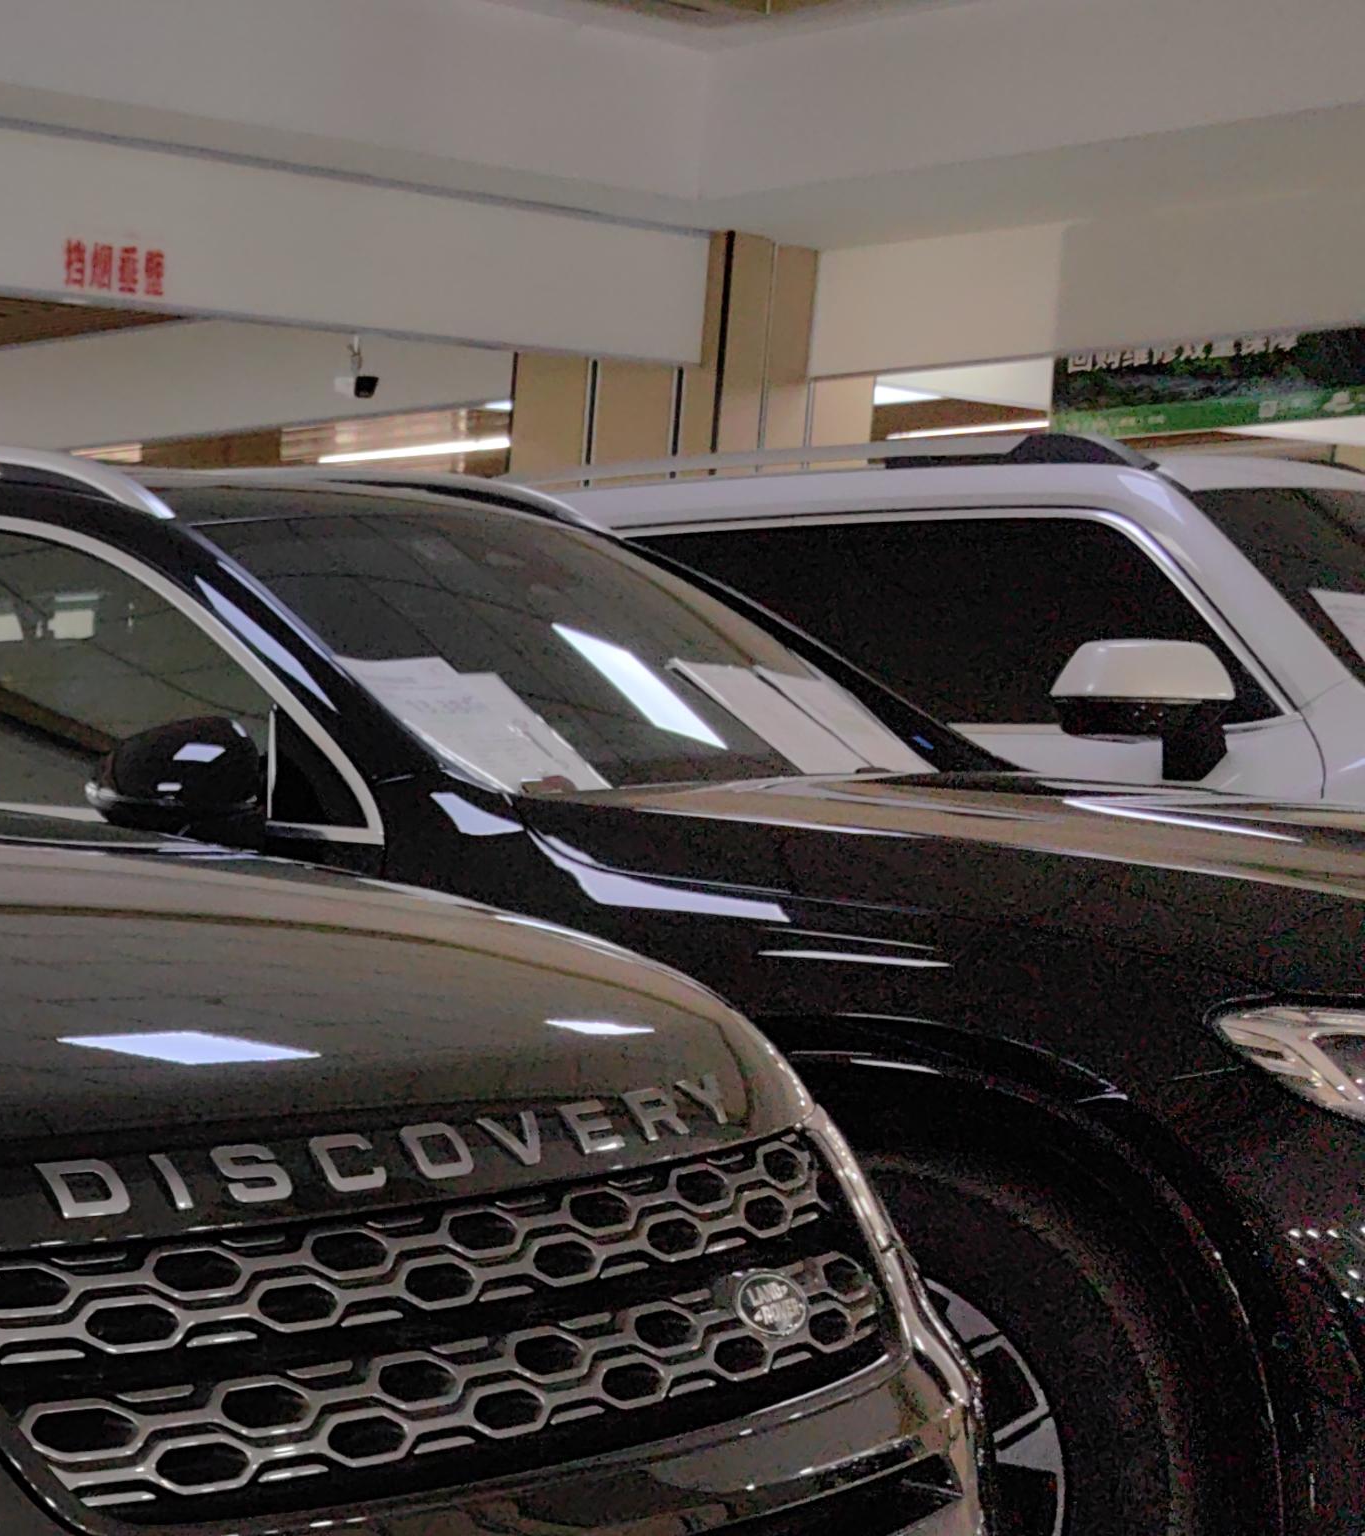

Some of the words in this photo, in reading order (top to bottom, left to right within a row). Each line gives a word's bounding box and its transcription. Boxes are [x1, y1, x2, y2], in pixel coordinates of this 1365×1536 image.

[33, 1073, 730, 1220] DISCOVERY
[745, 1281, 784, 1307] LAND
[760, 1297, 801, 1326] ROVER
